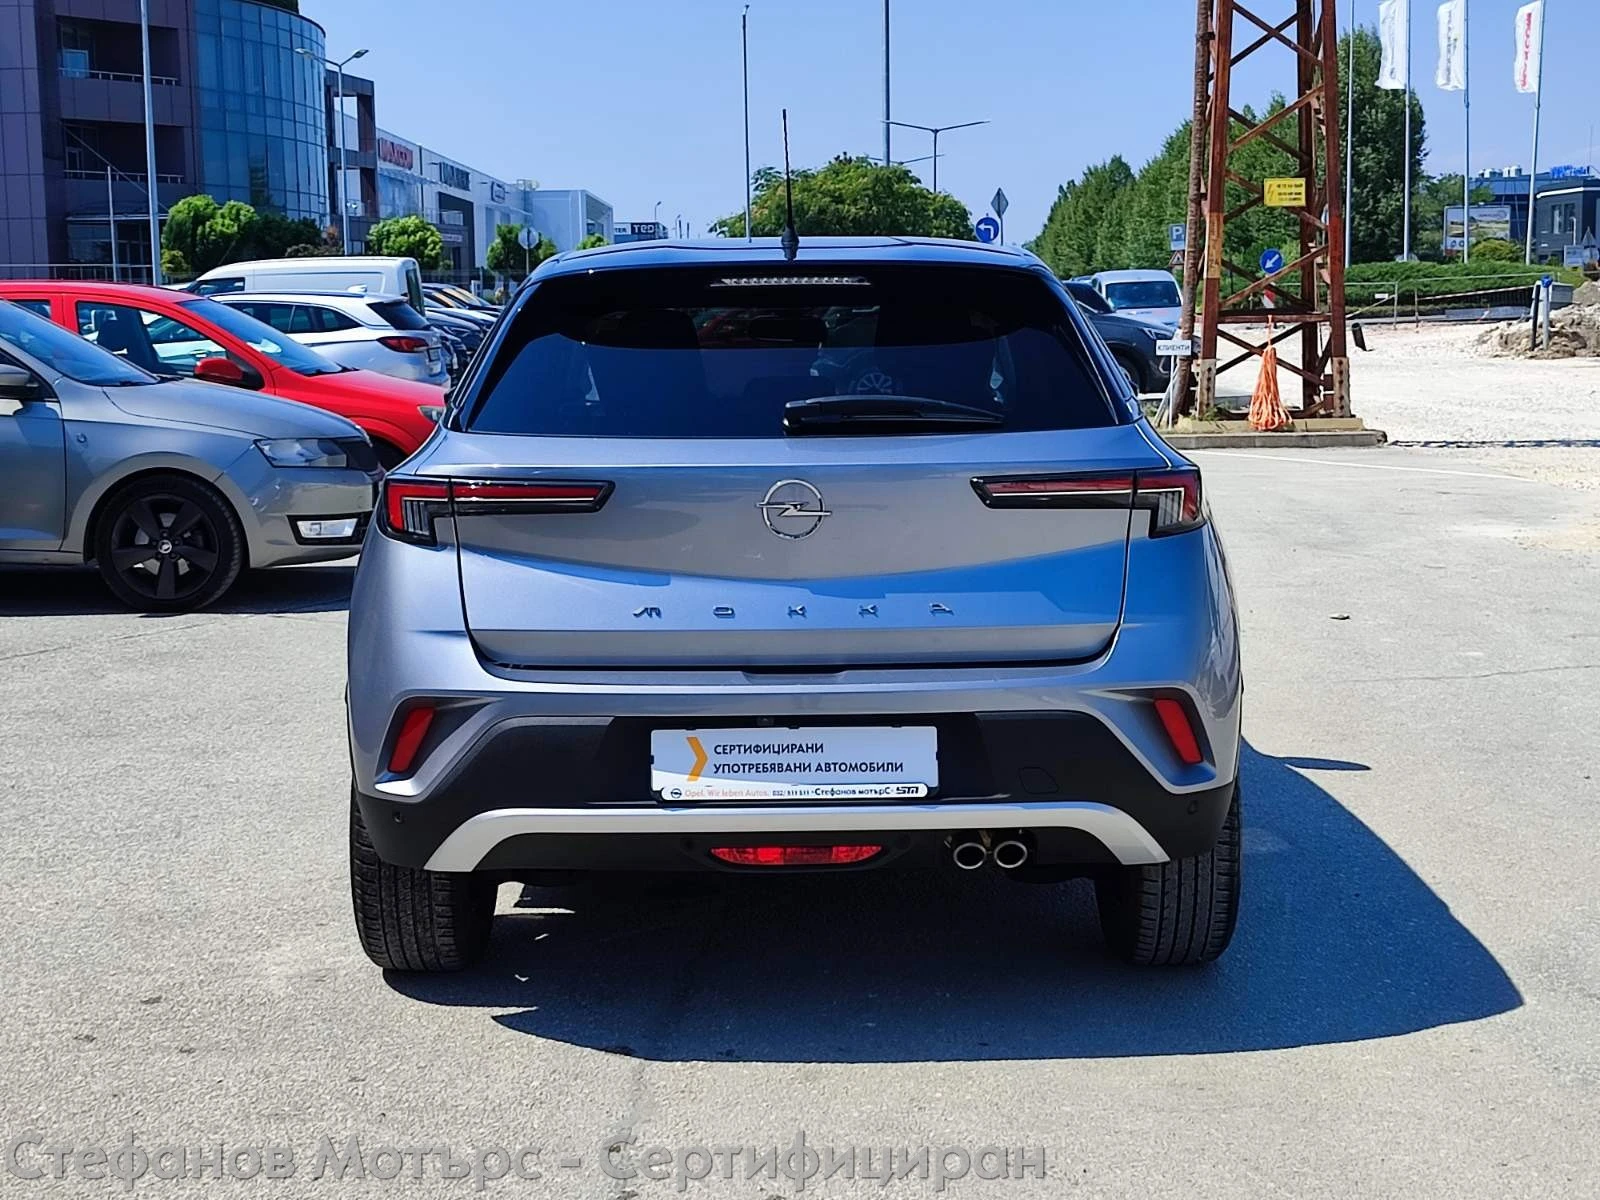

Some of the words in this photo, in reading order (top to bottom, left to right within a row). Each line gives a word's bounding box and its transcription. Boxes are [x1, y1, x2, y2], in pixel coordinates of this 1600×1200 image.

[1172, 226, 1183, 240] P
[713, 743, 824, 755] СЕРТИФИЦИРАНИ
[713, 763, 812, 774] УПОТРЕБЯВАНИ
[814, 762, 904, 773] АВТОМОБИЛИ
